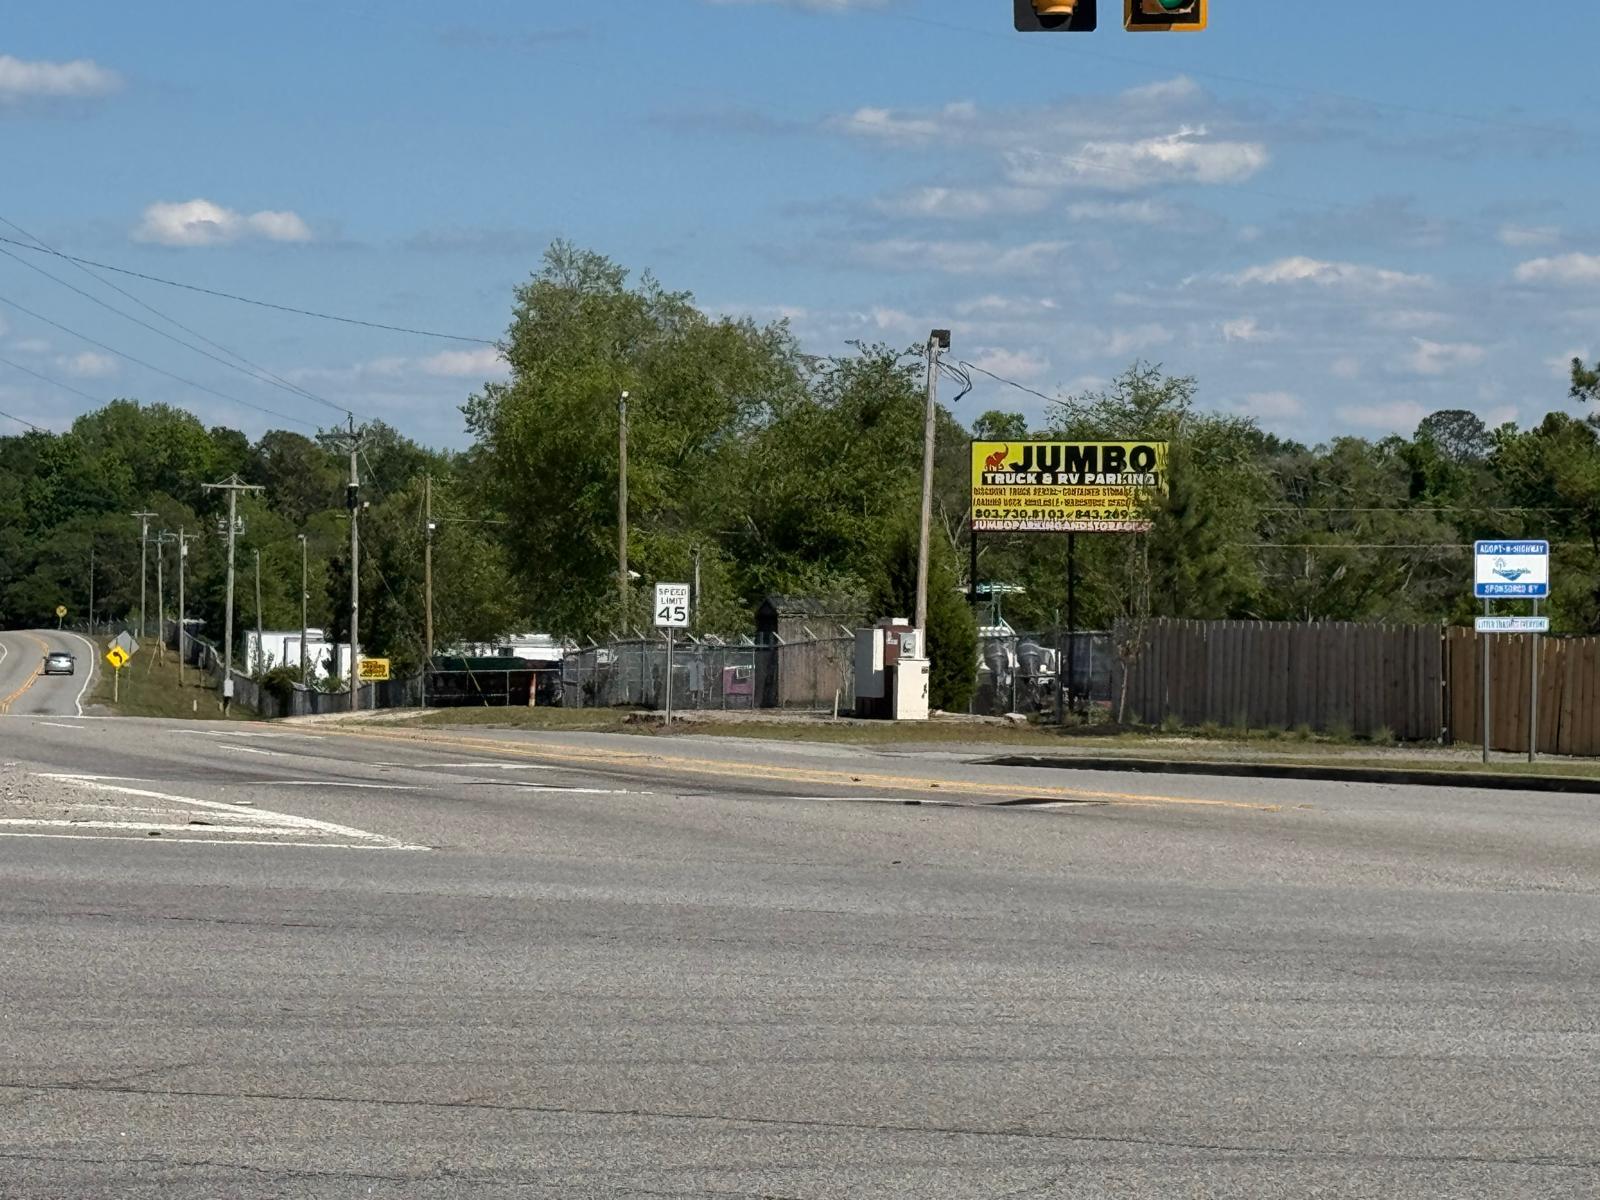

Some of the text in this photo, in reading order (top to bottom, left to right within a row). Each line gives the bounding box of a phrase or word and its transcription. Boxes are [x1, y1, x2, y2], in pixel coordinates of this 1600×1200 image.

[1008, 445, 1156, 473] JUMBO
[984, 473, 1155, 485] TRUCK & RV PARKING
[658, 588, 687, 596] SPEED
[660, 597, 684, 605] LIMIT
[657, 606, 686, 622] 45
